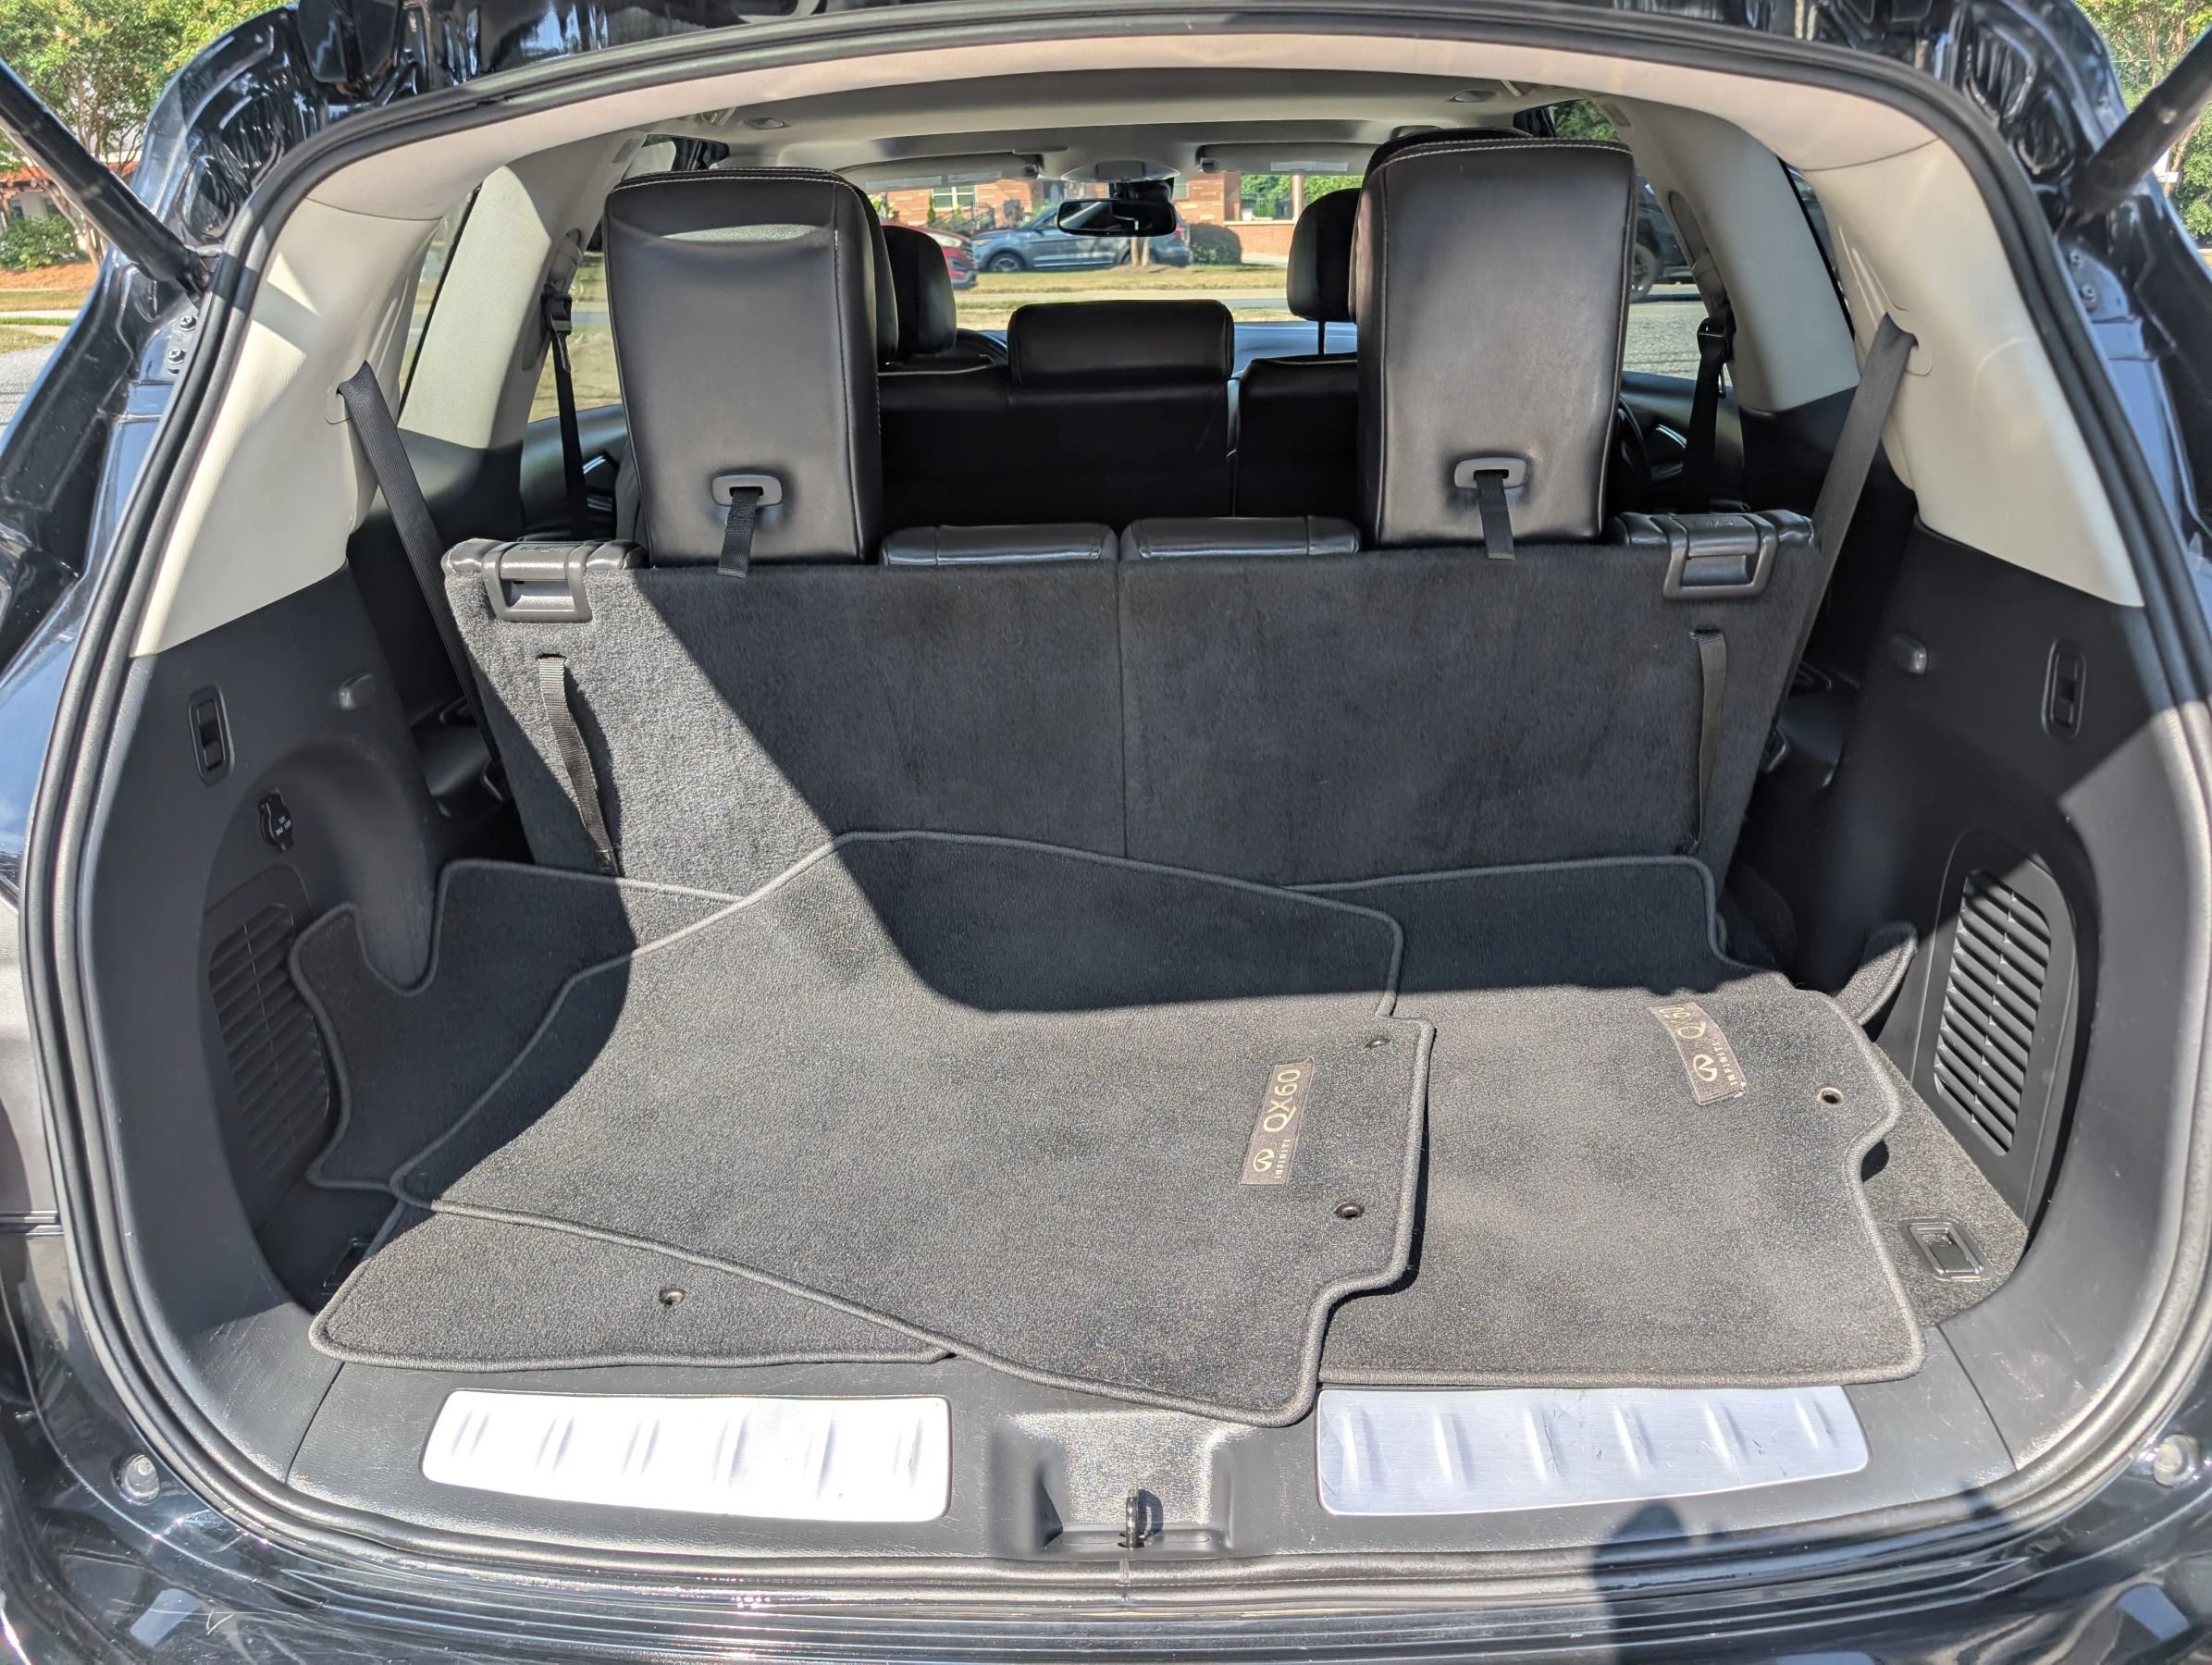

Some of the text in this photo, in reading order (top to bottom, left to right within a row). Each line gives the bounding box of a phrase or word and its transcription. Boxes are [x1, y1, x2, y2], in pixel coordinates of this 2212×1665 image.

[1712, 1042, 1738, 1086] INFINITI
[1263, 1069, 1301, 1132] QX60
[1274, 1139, 1291, 1178] INFINITI
